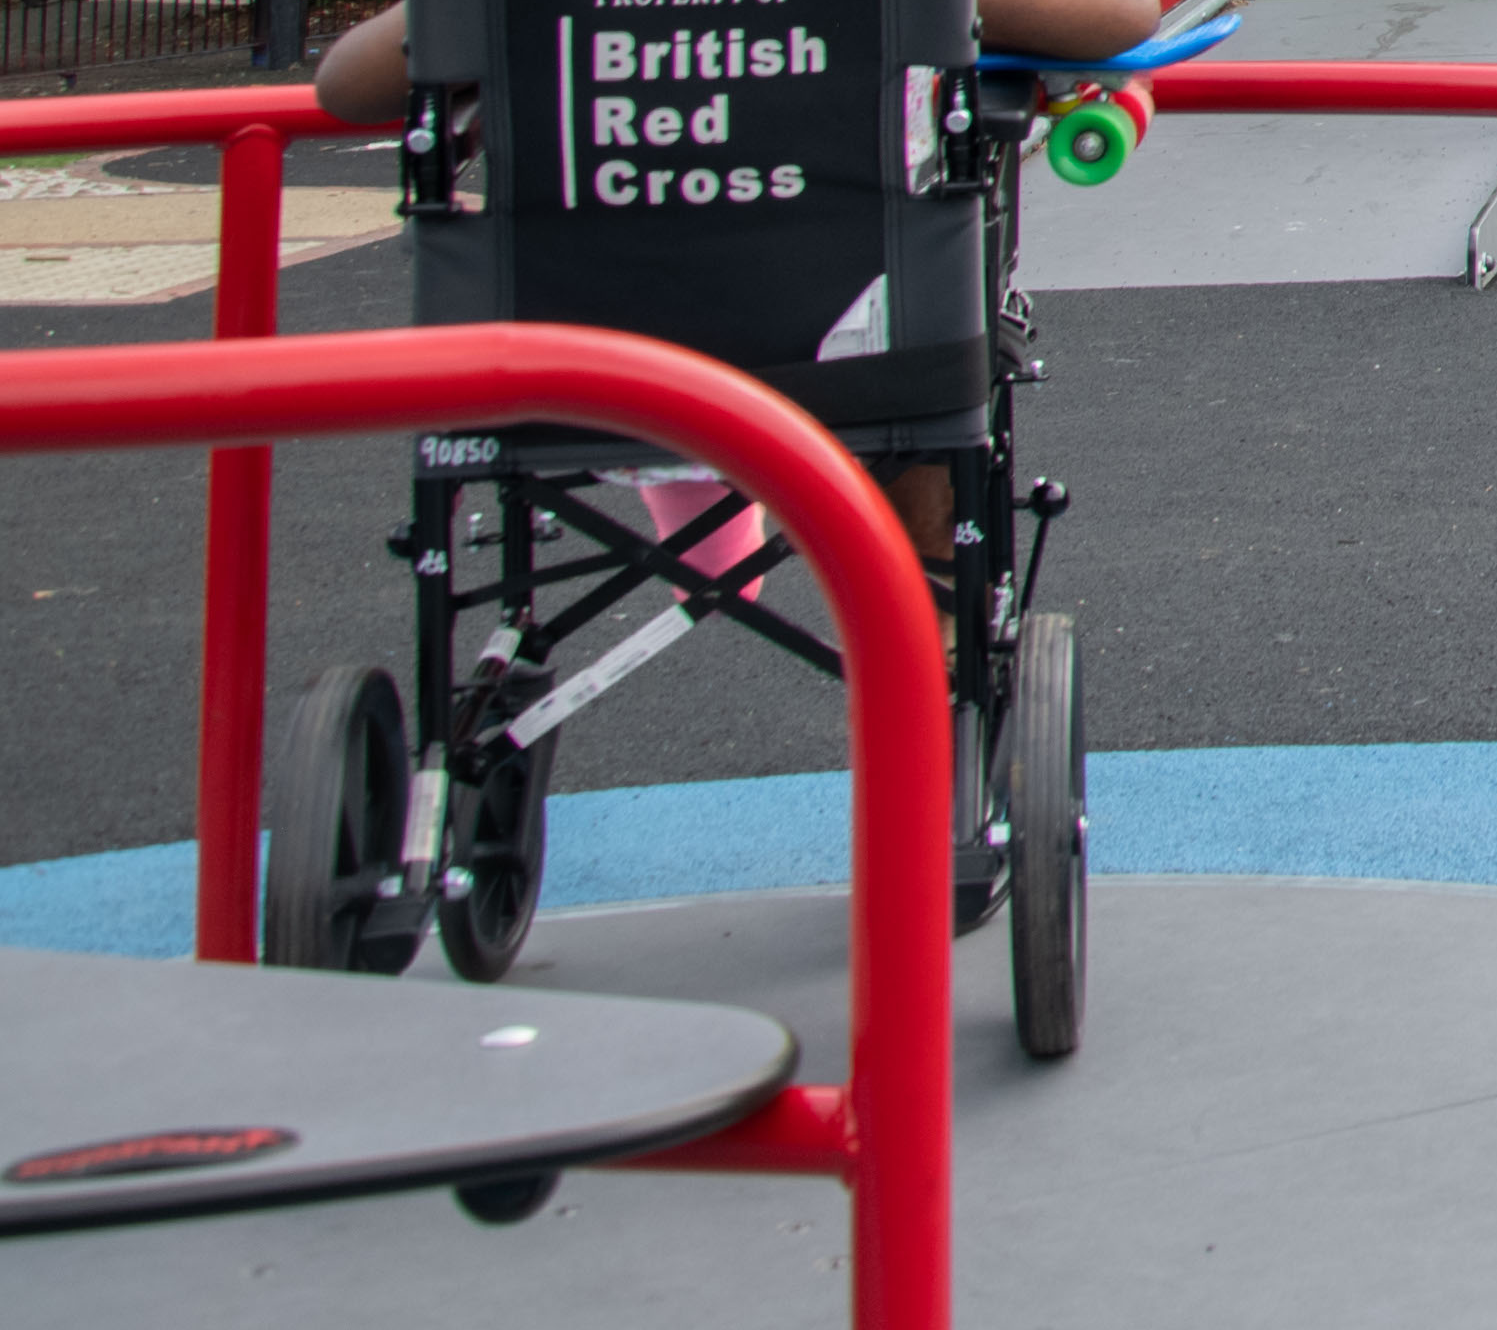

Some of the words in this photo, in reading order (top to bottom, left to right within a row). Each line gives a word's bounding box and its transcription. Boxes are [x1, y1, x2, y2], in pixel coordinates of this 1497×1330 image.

[594, 26, 828, 81] British
[594, 93, 730, 146] Red
[594, 159, 806, 206] Cross
[421, 435, 501, 467] 90850
